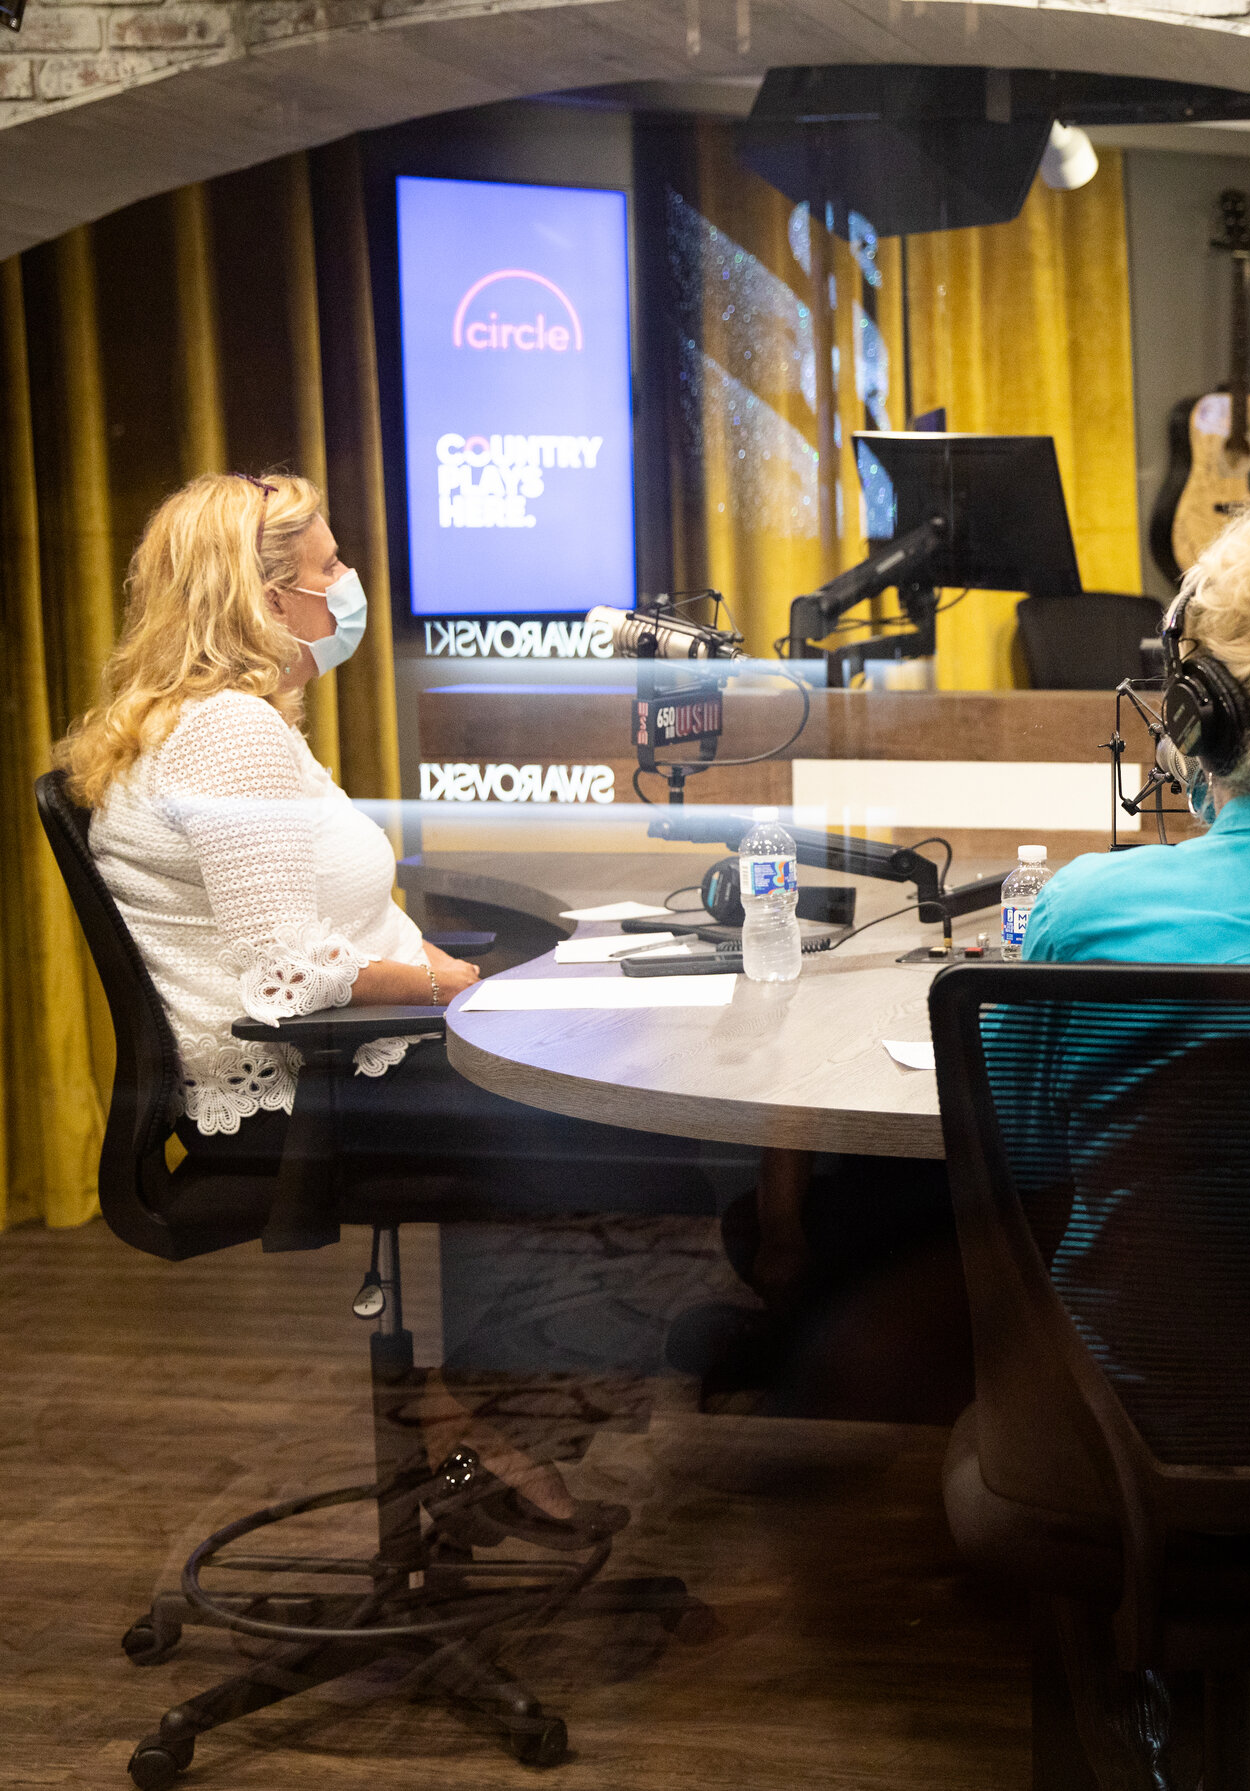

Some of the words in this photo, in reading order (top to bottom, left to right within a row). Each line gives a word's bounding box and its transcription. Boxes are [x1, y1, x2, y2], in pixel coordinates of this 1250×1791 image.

[466, 312, 571, 352] circle
[436, 433, 603, 468] COUNTRY
[437, 464, 544, 498] PLAYS
[439, 495, 537, 528] HERE.
[657, 706, 675, 728] 650
